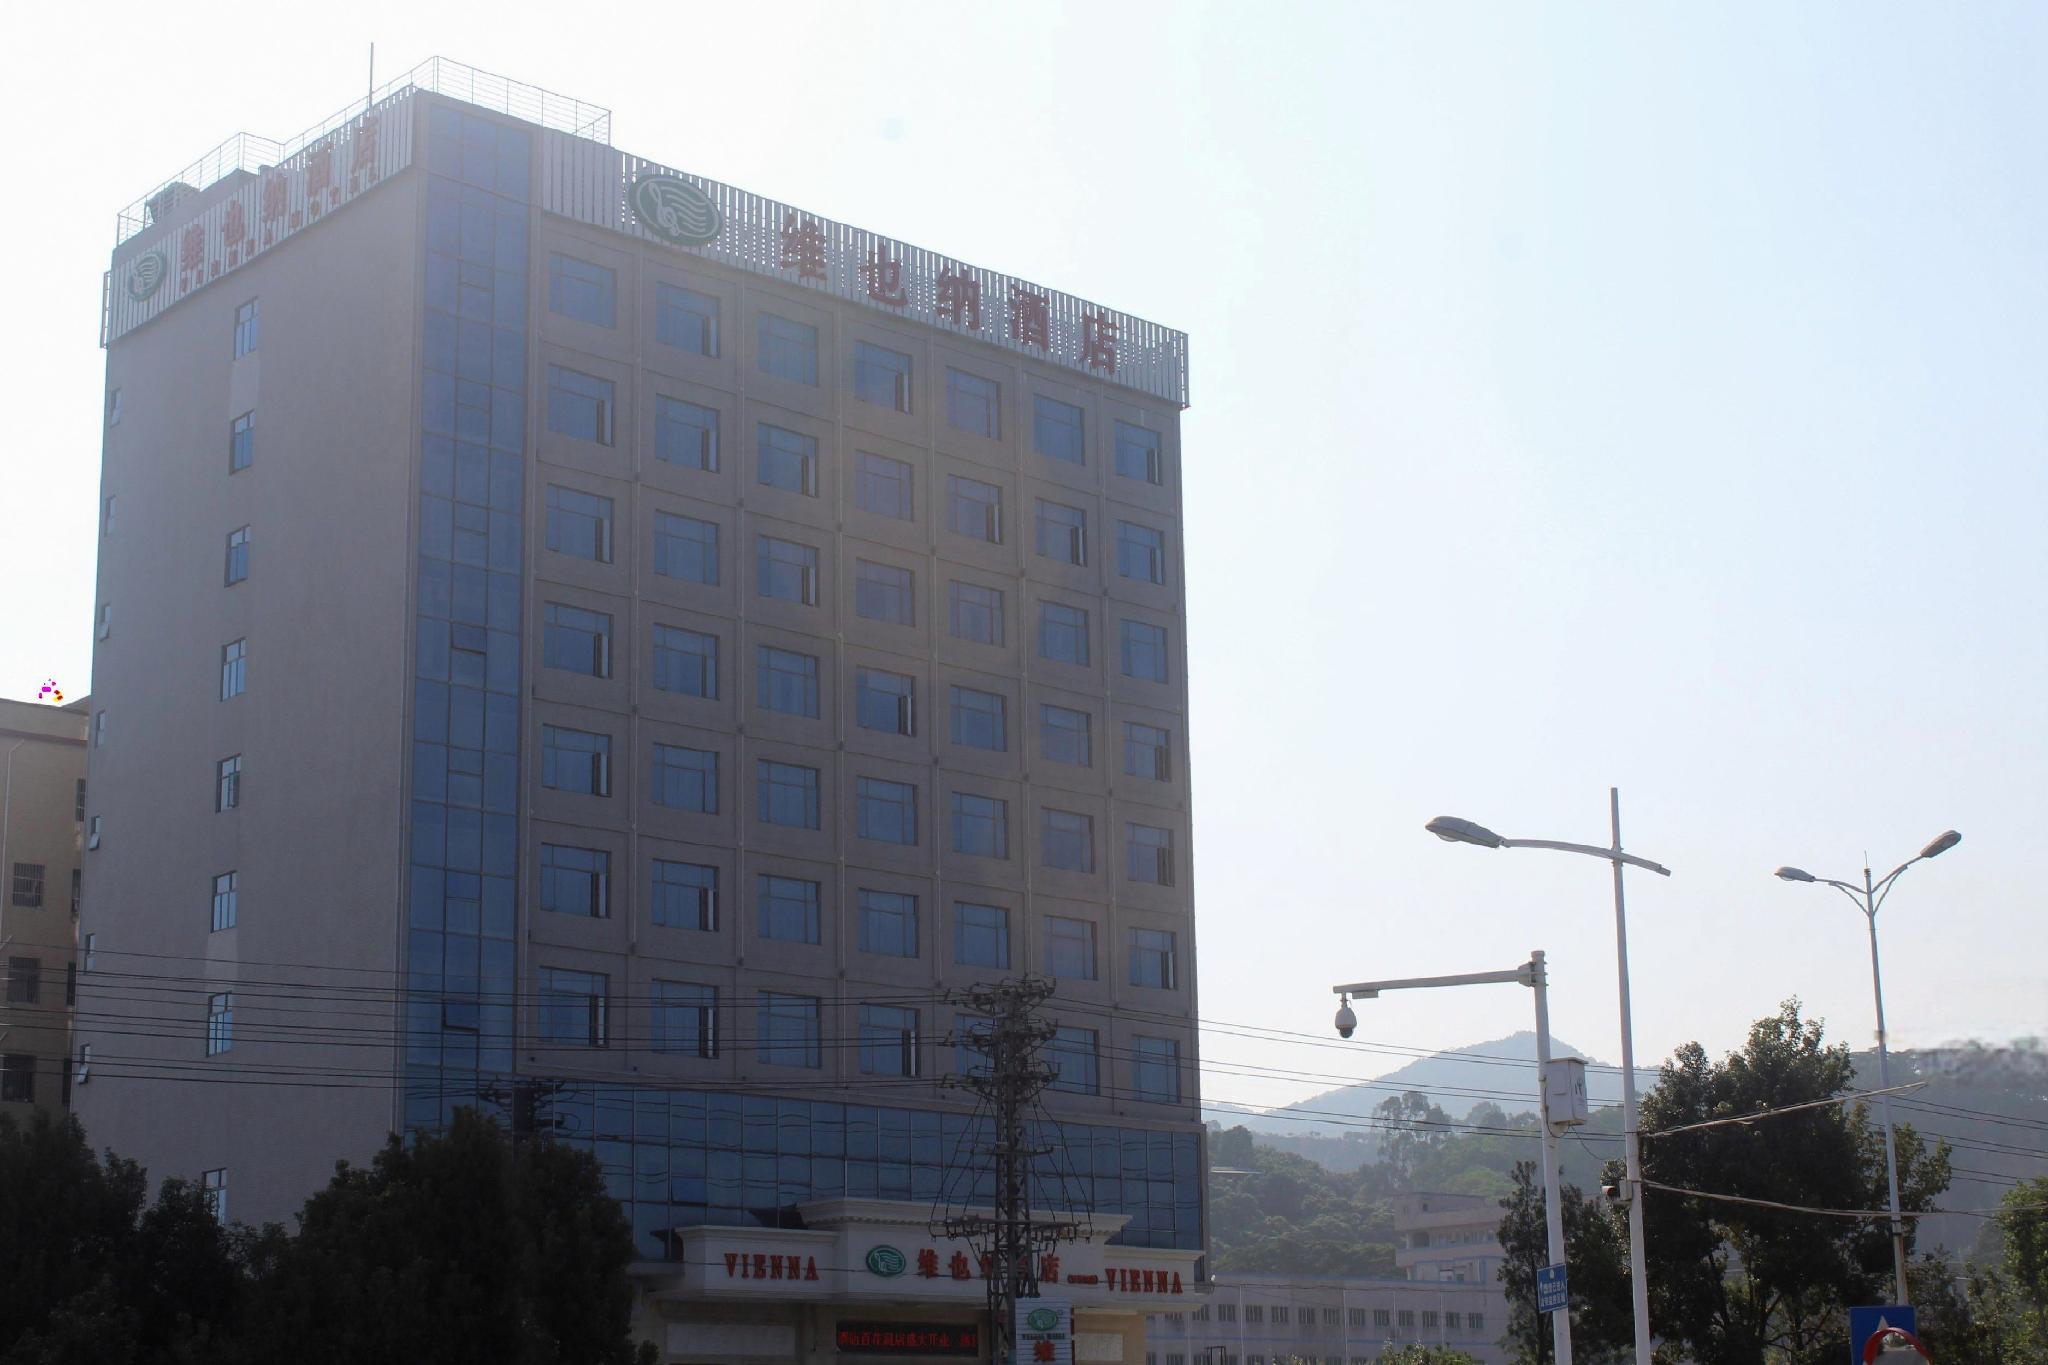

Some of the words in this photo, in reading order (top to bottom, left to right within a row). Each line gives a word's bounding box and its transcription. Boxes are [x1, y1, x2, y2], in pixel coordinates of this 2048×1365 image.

[780, 214, 1117, 376] 维也纳酒店
[724, 1252, 819, 1281] VIENNA
[1104, 1268, 1184, 1295] VIENNA
